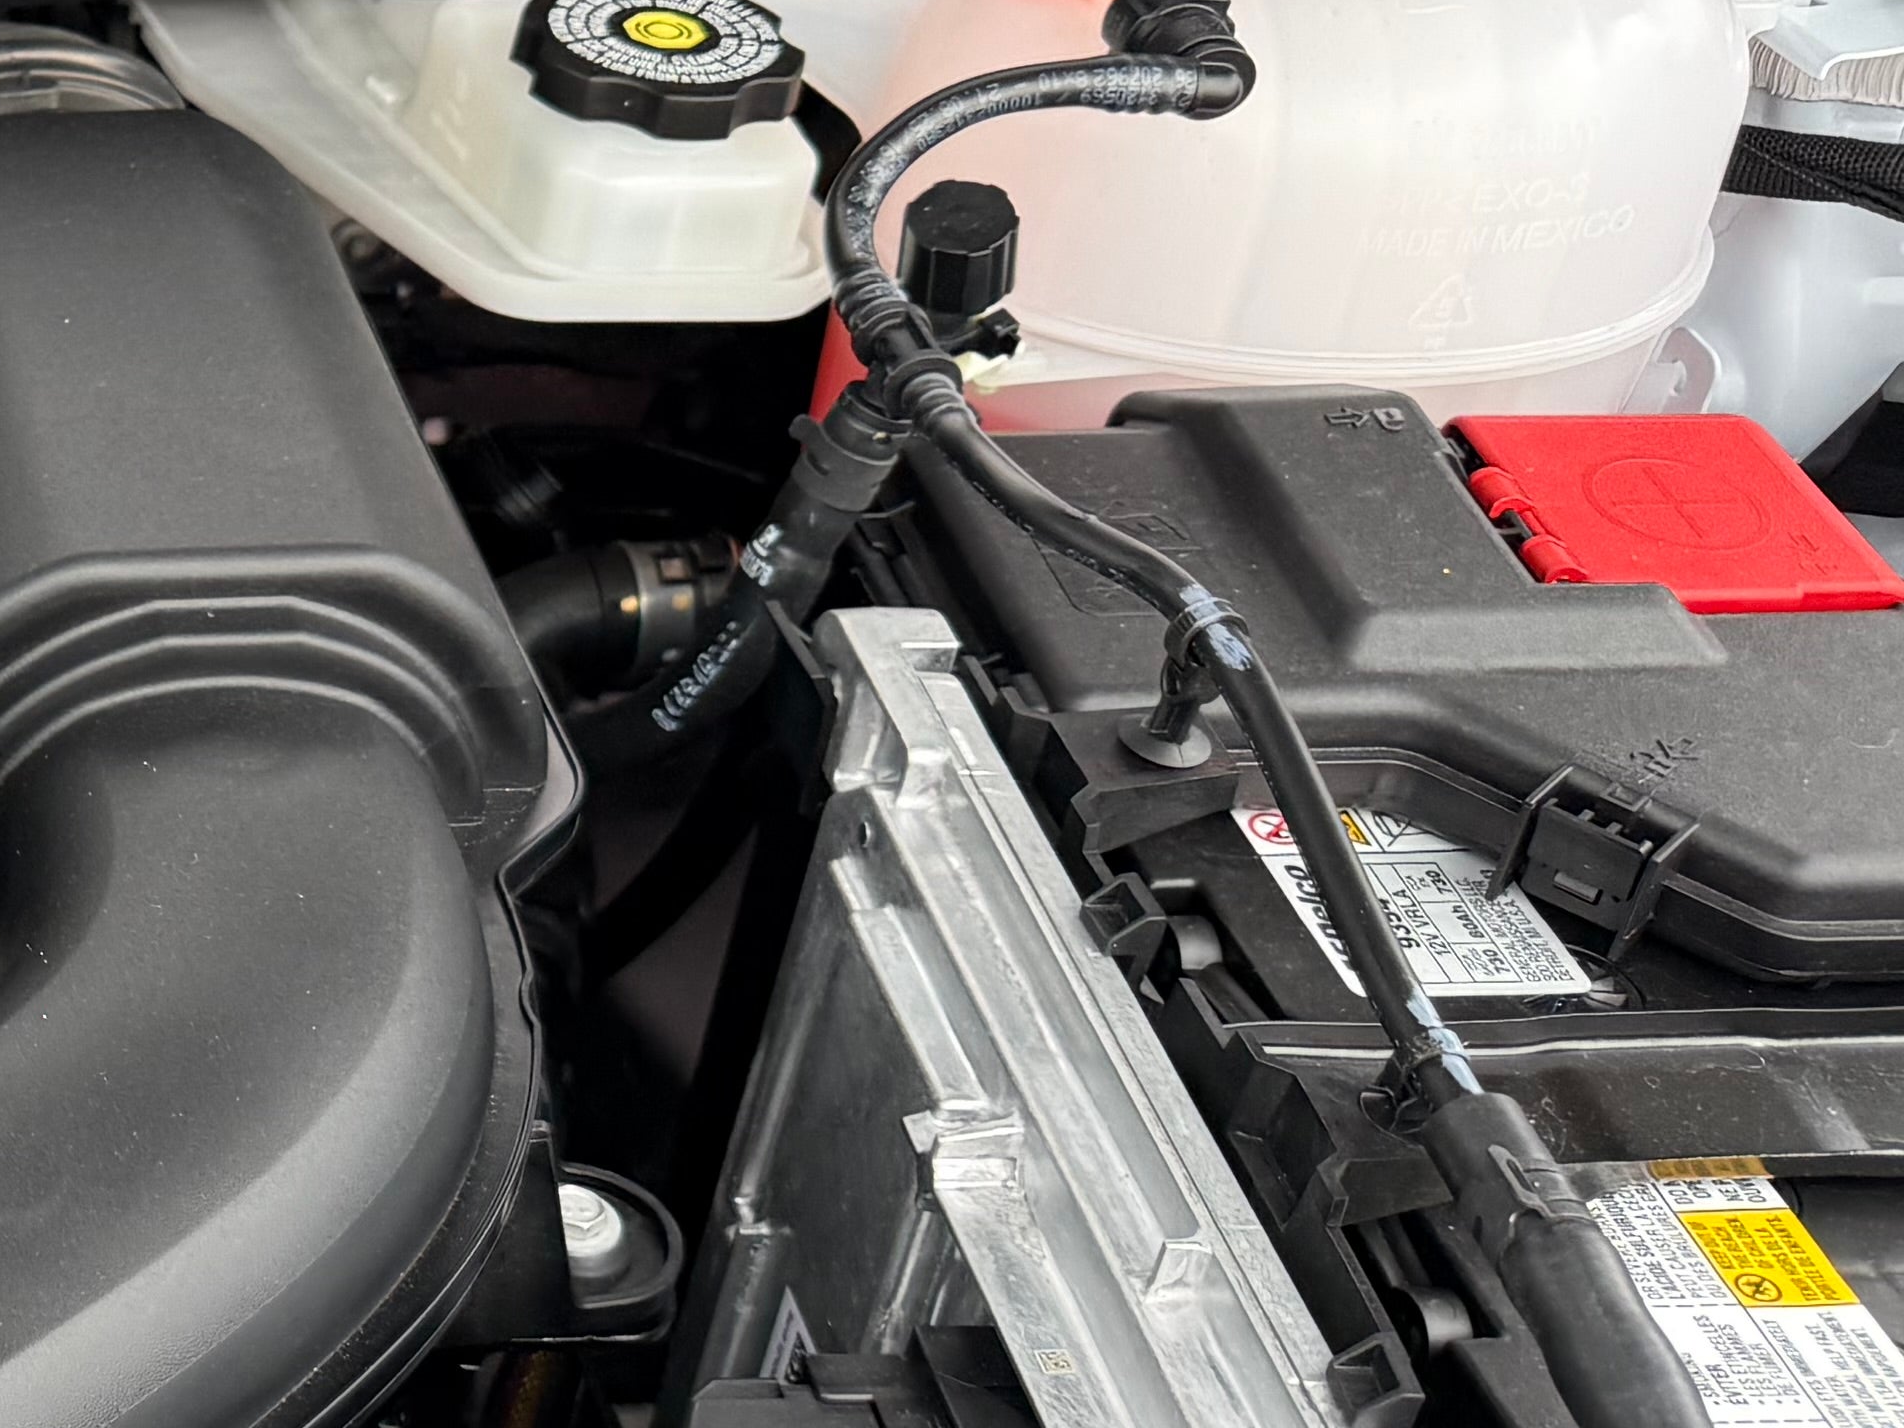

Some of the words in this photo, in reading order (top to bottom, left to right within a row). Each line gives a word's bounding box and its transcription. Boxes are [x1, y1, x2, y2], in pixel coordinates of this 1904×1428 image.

[1356, 225, 1449, 257] MADE
[1454, 225, 1489, 254] IN
[1490, 203, 1636, 254] MEXICO
[1423, 870, 1454, 894] 730
[1388, 889, 1432, 928] VRLA
[1467, 898, 1508, 937] MOTORS
[1447, 905, 1485, 937] 80Ah
[1421, 933, 1452, 954] 12V
[1480, 949, 1511, 973] 730
[1499, 942, 1541, 981] GENERAL
[1632, 1214, 1655, 1225] LA
[1695, 1233, 1720, 1246] OUT
[1711, 1226, 1743, 1251] REACH
[1752, 1227, 1773, 1237] LA
[1644, 1229, 1687, 1268] CAUSER
[1763, 1240, 1783, 1250] DE
[1706, 1249, 1736, 1268] KEEP
[1731, 1254, 1754, 1268] THE
[1752, 1259, 1775, 1268] OF
[1641, 1260, 1686, 1298] L'ACIDE
[1716, 1324, 1765, 1374] FLAMMES
[1747, 1343, 1787, 1378] FUMER
[1737, 1378, 1765, 1396] LES
[1755, 1378, 1782, 1395] LES
[1777, 1384, 1800, 1395] DE
[1805, 1379, 1834, 1400] EYES
[1822, 1375, 1858, 1405] WATER
